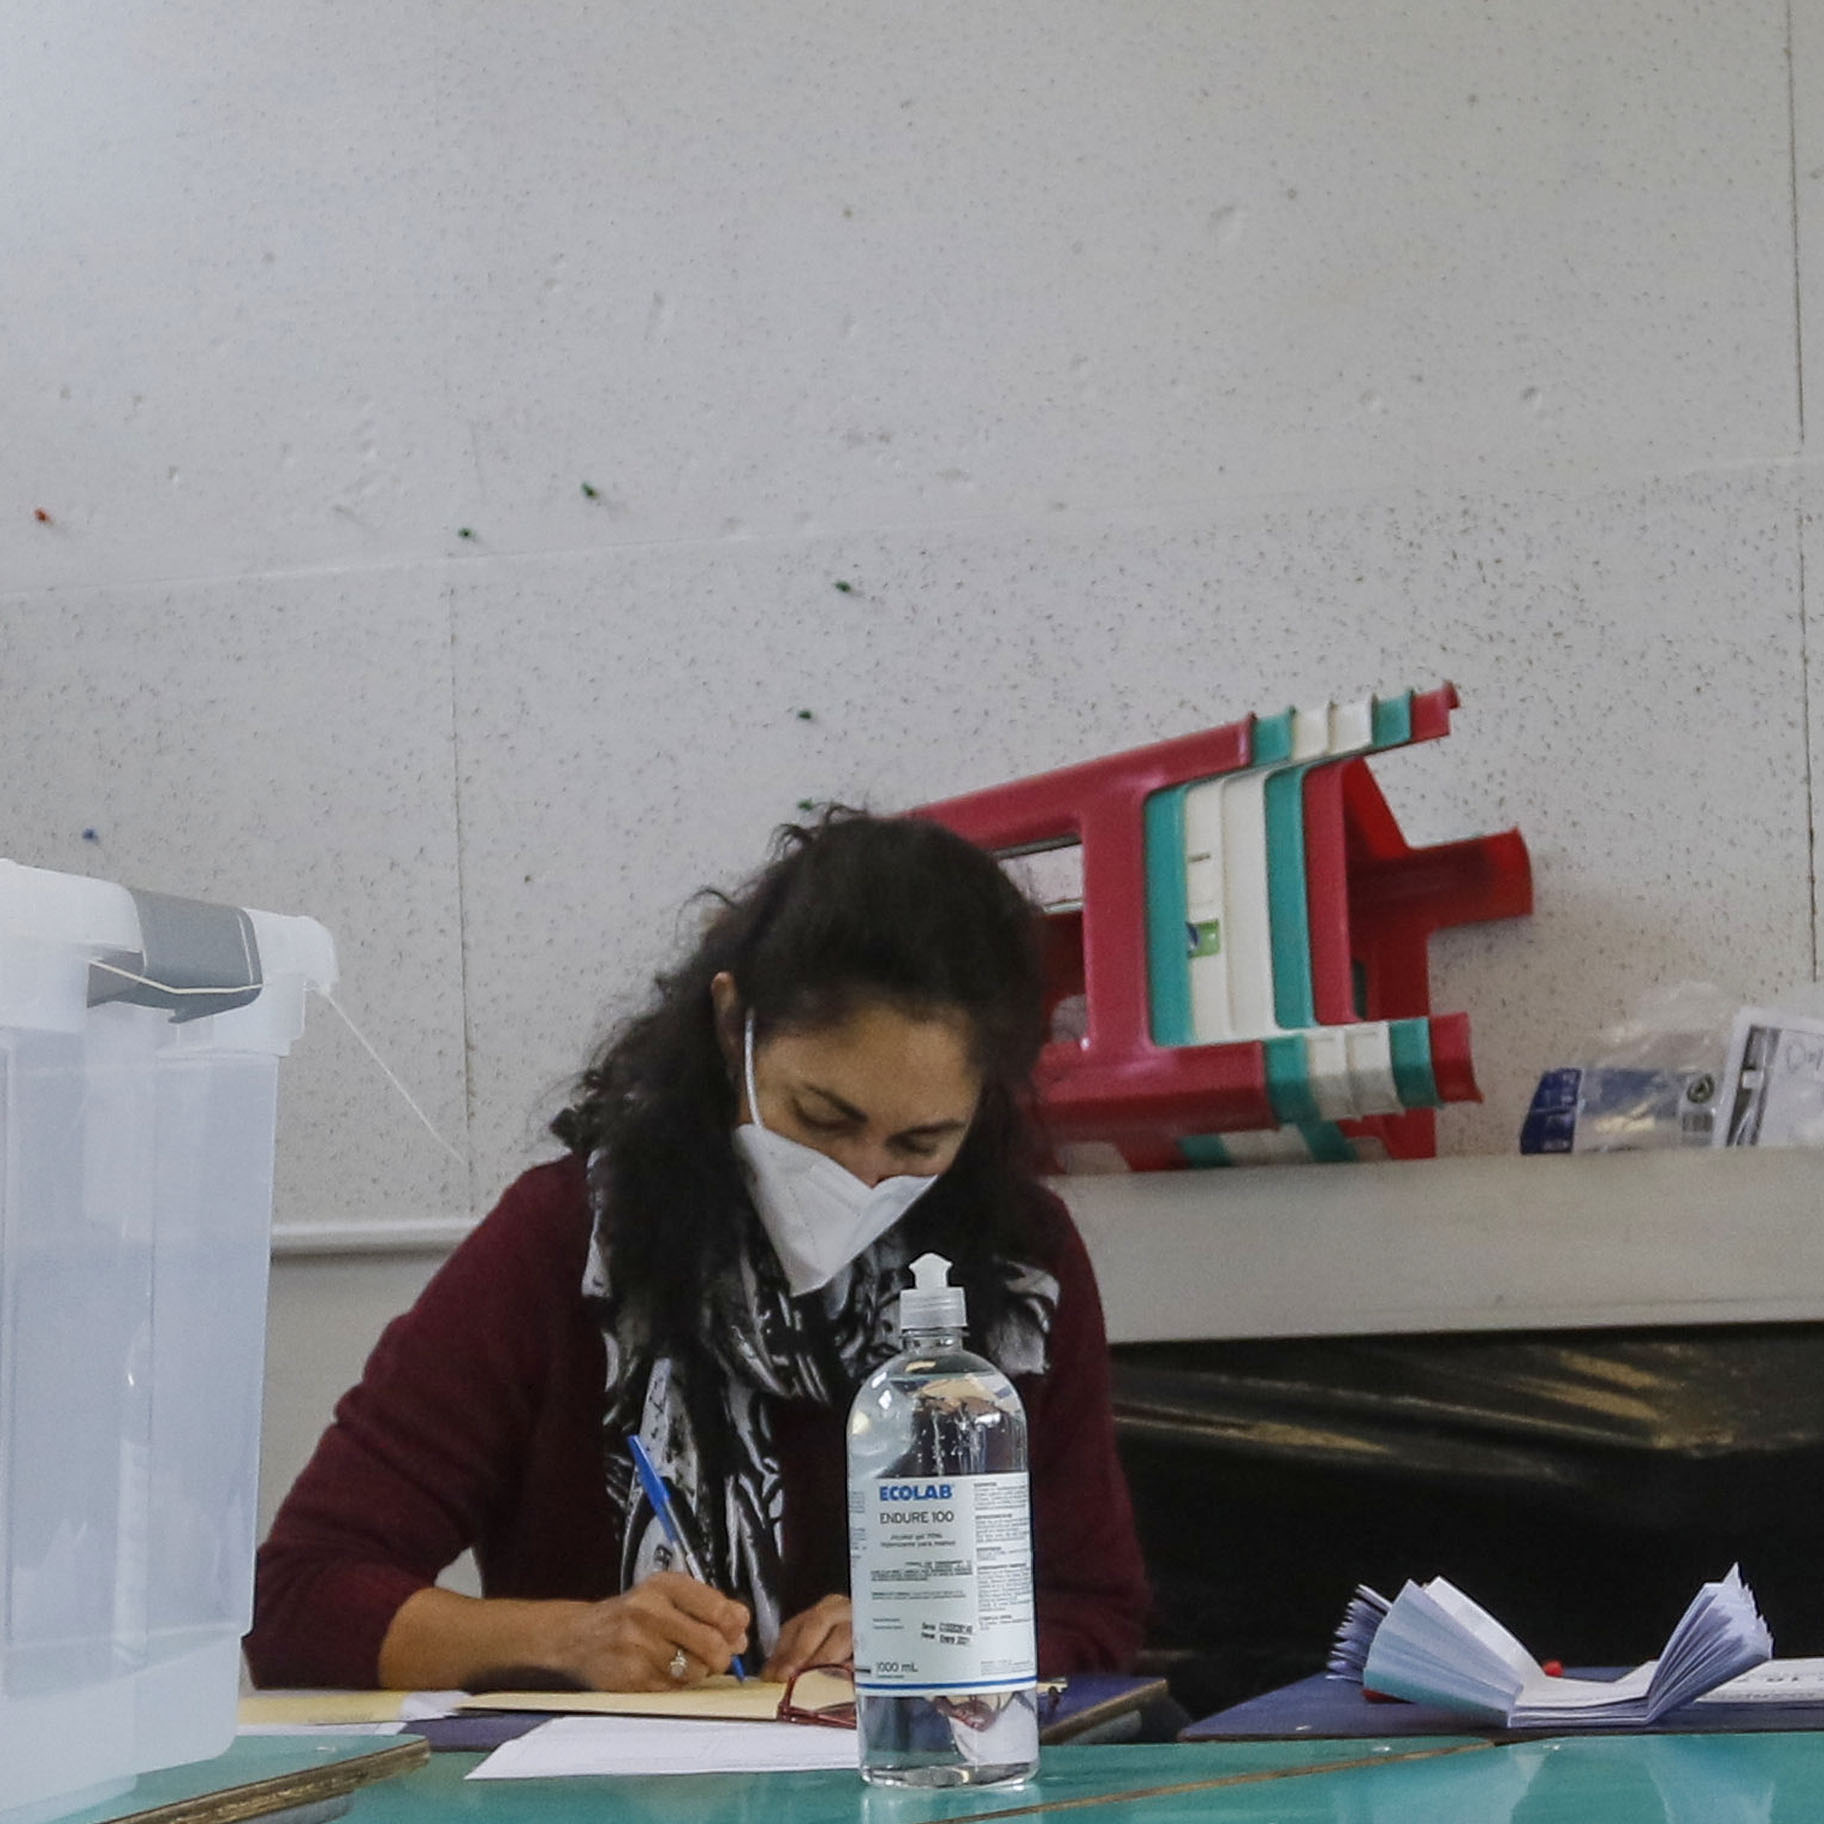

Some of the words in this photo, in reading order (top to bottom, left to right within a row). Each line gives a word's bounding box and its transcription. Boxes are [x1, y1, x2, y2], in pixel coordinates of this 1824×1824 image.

[879, 1484, 953, 1501] ECOLAB
[879, 1511, 929, 1524] ENDURE
[931, 1510, 955, 1522] 100
